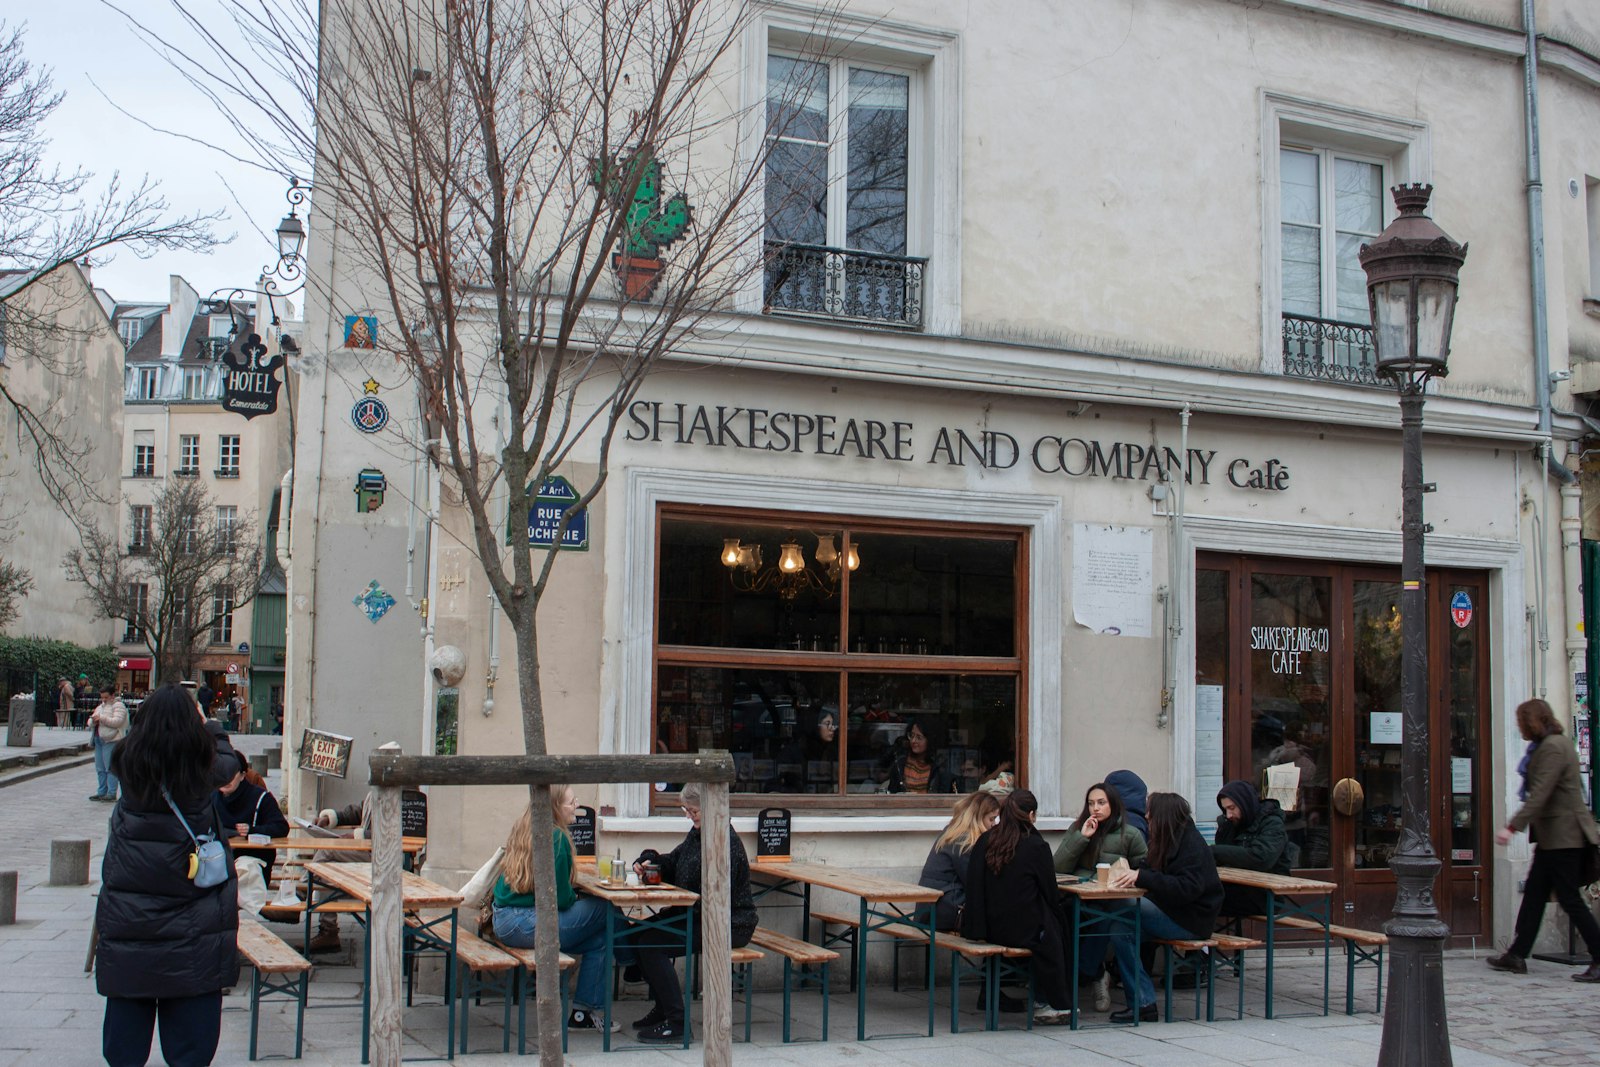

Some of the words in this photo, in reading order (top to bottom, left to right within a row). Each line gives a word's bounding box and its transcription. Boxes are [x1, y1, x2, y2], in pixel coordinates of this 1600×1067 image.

[229, 371, 272, 394] HOTEL
[625, 401, 914, 461] SHAKESPEARE
[926, 426, 1020, 469] AND
[1031, 435, 1217, 485] COMPANY
[1227, 459, 1290, 491] Café
[537, 508, 562, 519] RUE
[1458, 610, 1465, 619] R
[1271, 651, 1302, 675] CAFE
[317, 741, 336, 755] EXIT
[311, 753, 336, 769] SORTIE
